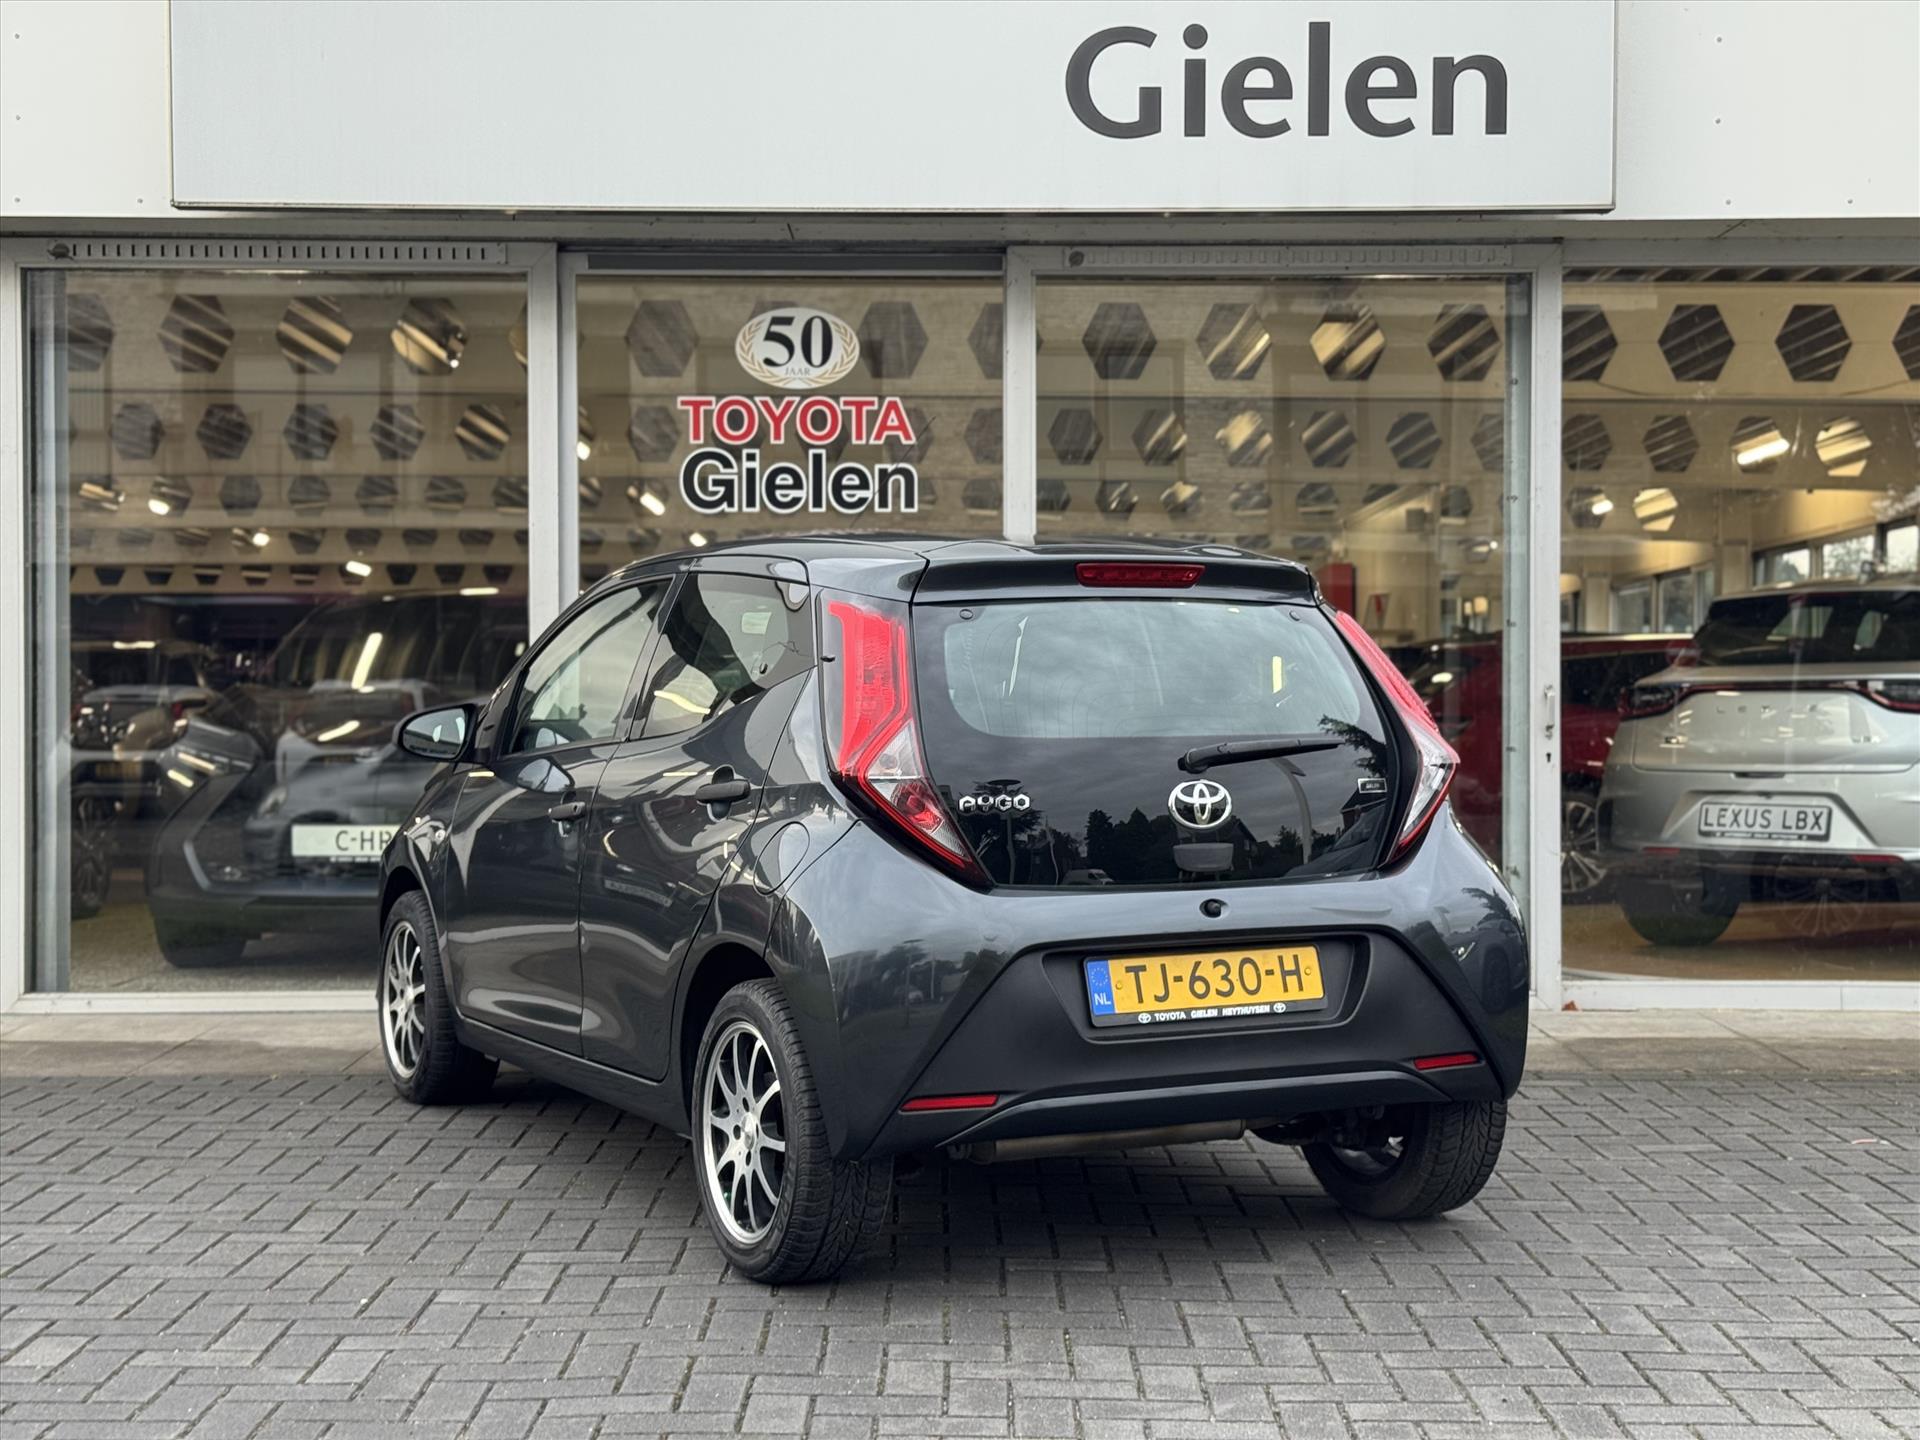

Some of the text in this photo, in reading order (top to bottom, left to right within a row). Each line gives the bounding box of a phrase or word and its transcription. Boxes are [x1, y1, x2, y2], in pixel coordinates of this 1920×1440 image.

[1065, 21, 1508, 139] Gielen
[763, 315, 833, 368] 50
[785, 367, 811, 376] JAAR
[678, 396, 917, 445] TOYOTA
[679, 447, 918, 514] Gielen
[959, 794, 1030, 812] AYGO
[1703, 808, 1823, 831] LEXUS LBX
[1124, 954, 1304, 1004] TJ-630-H
[1094, 993, 1111, 1005] NL
[1154, 1005, 1270, 1021] TOYOTA GIELEN HEYTHUYSEN
